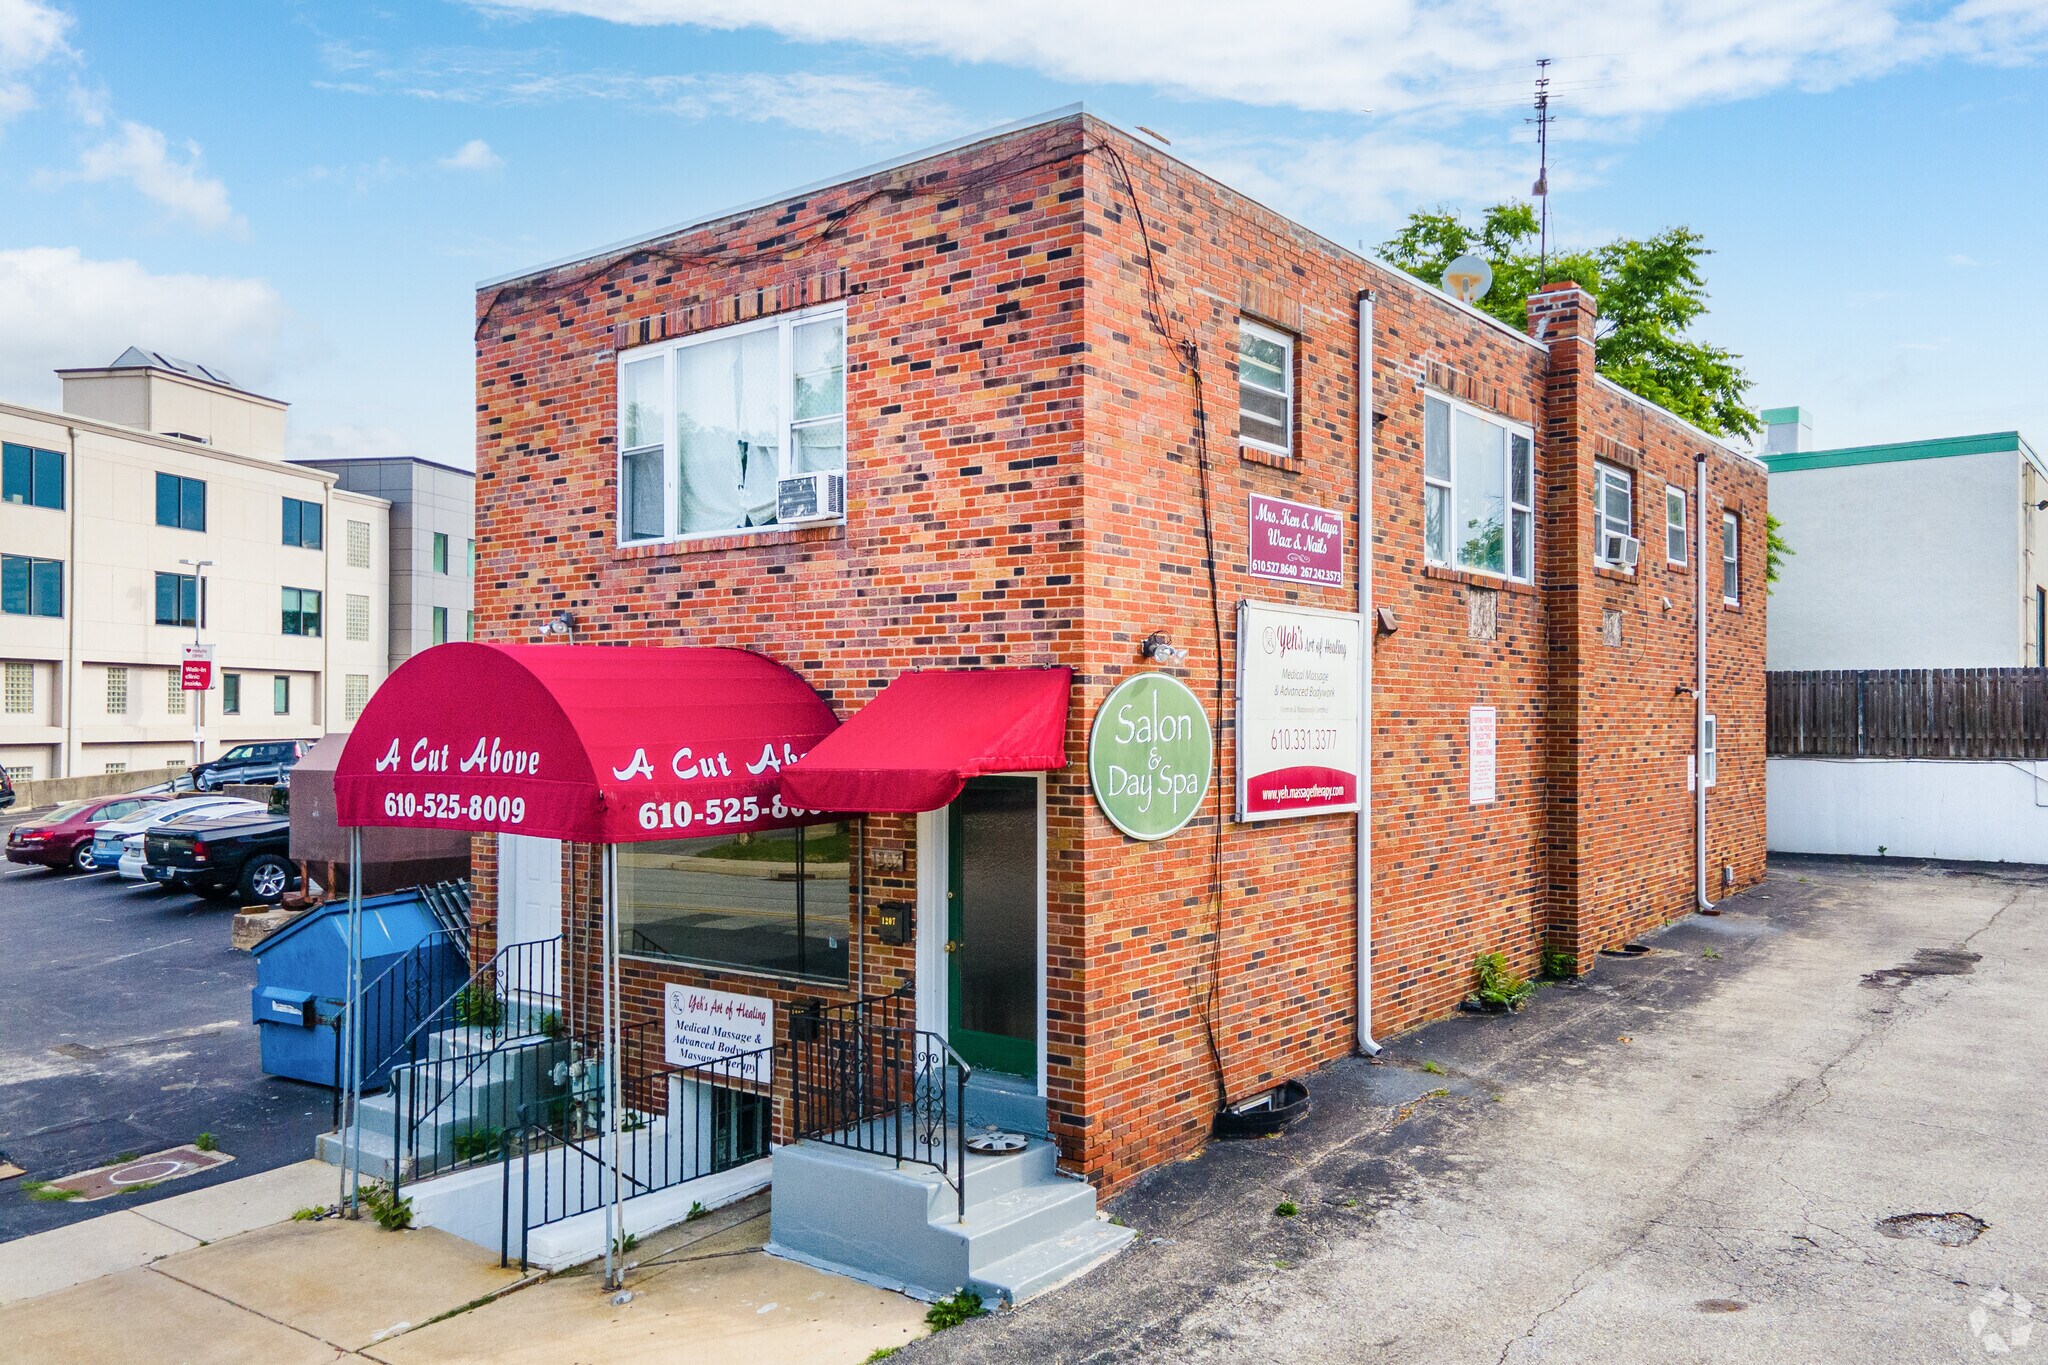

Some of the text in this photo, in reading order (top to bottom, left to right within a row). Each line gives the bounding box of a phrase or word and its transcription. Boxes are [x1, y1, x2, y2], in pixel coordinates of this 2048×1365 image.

[1255, 503, 1339, 539] Mrs. Ken & Maya
[1267, 528, 1327, 554] Wax & Nails
[1252, 559, 1341, 582] 610.527.8640 267.242.3573
[1277, 625, 1347, 660] Yeh's Art of Healing
[1282, 668, 1329, 684] Medical Massage
[1280, 685, 1309, 697] Advanced
[1309, 686, 1336, 700] Bodywork
[1115, 689, 1192, 744] Salon
[1271, 729, 1337, 750] 610.331.3377
[376, 736, 540, 775] A Cut Above
[612, 748, 655, 781] A
[672, 747, 732, 780] Cut
[1148, 746, 1162, 770] &
[1108, 765, 1198, 814] Day Spa
[1262, 784, 1345, 803] www.yeh.massagetherapy.com
[384, 792, 525, 824] 610-525-8009
[638, 793, 834, 830] 610-525-8
[881, 916, 896, 926] 1207
[689, 994, 767, 1026] Yeh's Art of Healing
[673, 1034, 715, 1050] Advanced
[675, 1019, 762, 1044] Medical Massage &
